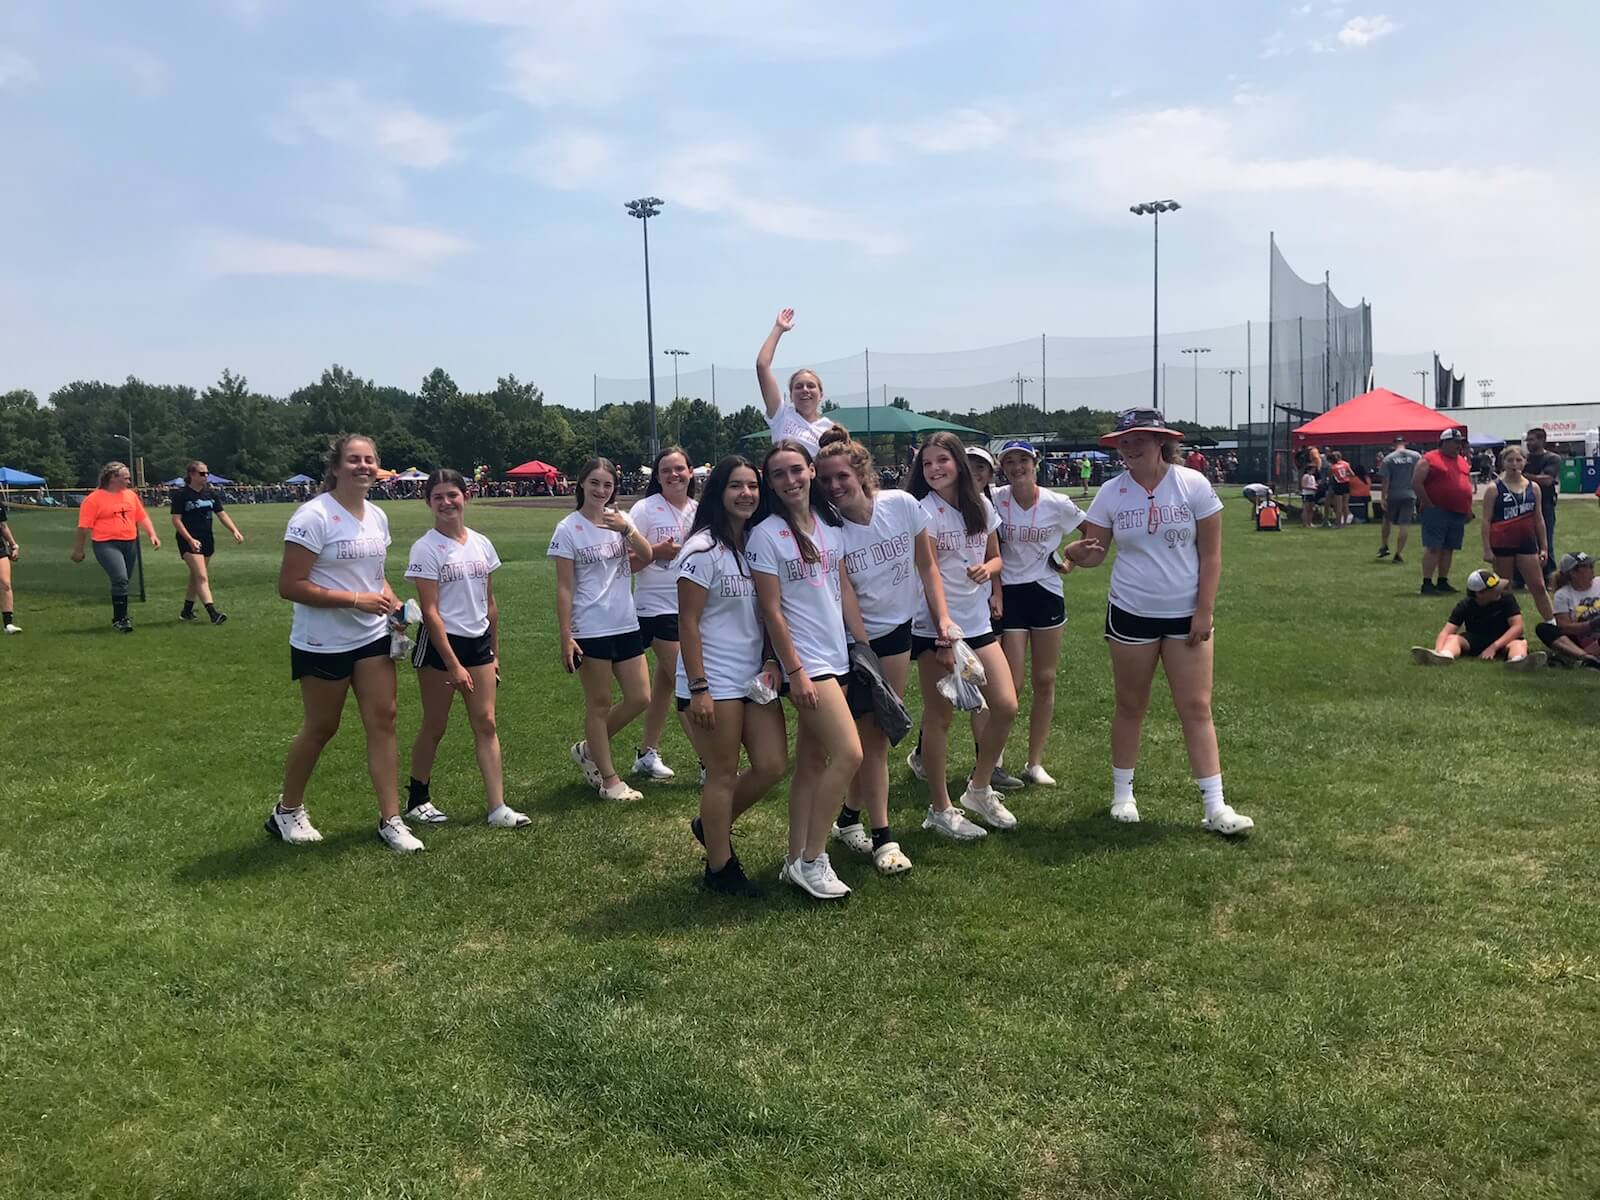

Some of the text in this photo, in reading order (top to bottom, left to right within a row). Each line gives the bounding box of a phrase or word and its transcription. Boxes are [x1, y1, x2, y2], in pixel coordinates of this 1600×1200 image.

[1117, 503, 1191, 530] HIT DOGS
[336, 538, 385, 560] HIT DO
[870, 532, 909, 566] DOGS
[1164, 528, 1191, 549] 99
[578, 545, 602, 565] HIT
[439, 561, 488, 584] HIT DO
[720, 574, 749, 598] HIT
